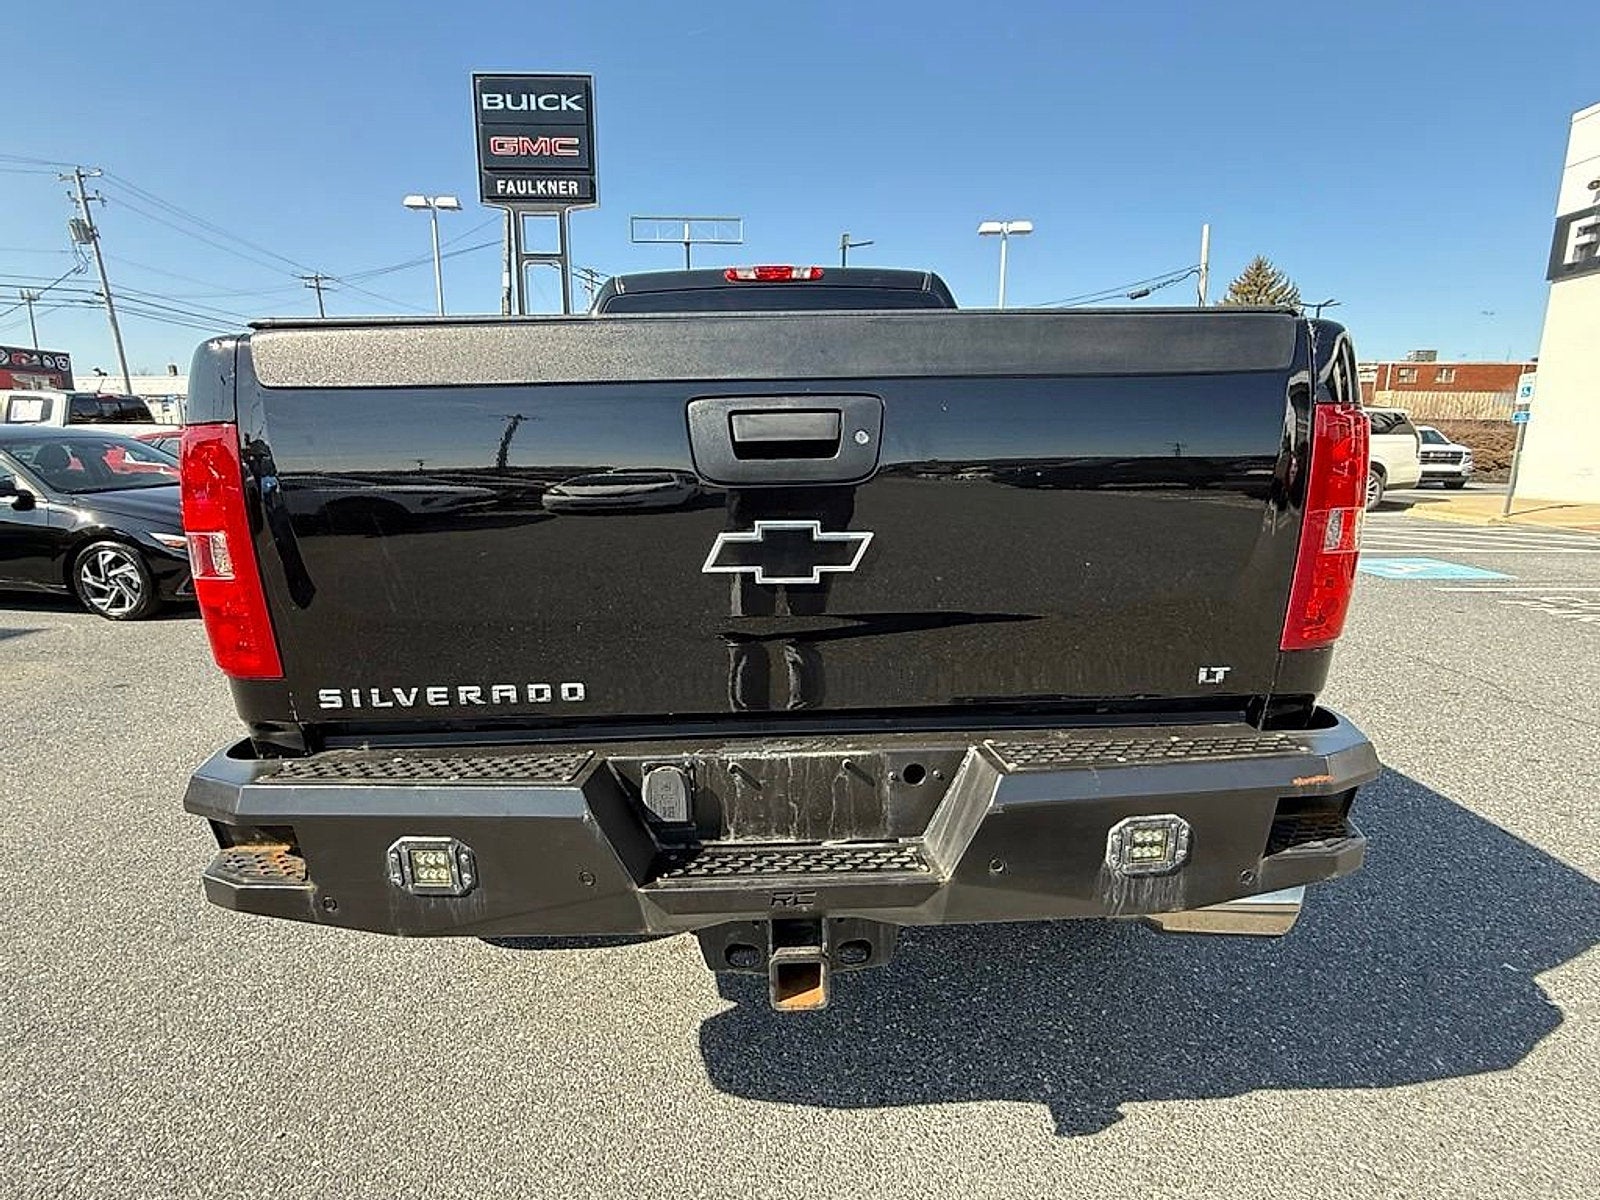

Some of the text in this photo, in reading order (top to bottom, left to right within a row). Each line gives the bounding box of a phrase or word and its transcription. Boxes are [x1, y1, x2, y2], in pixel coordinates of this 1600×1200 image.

[482, 93, 584, 111] BUICK
[490, 136, 580, 156] GMC
[496, 179, 579, 195] FAULKNER
[1563, 214, 1600, 264] F
[1198, 666, 1232, 685] LT
[318, 682, 586, 709] SILVERADO
